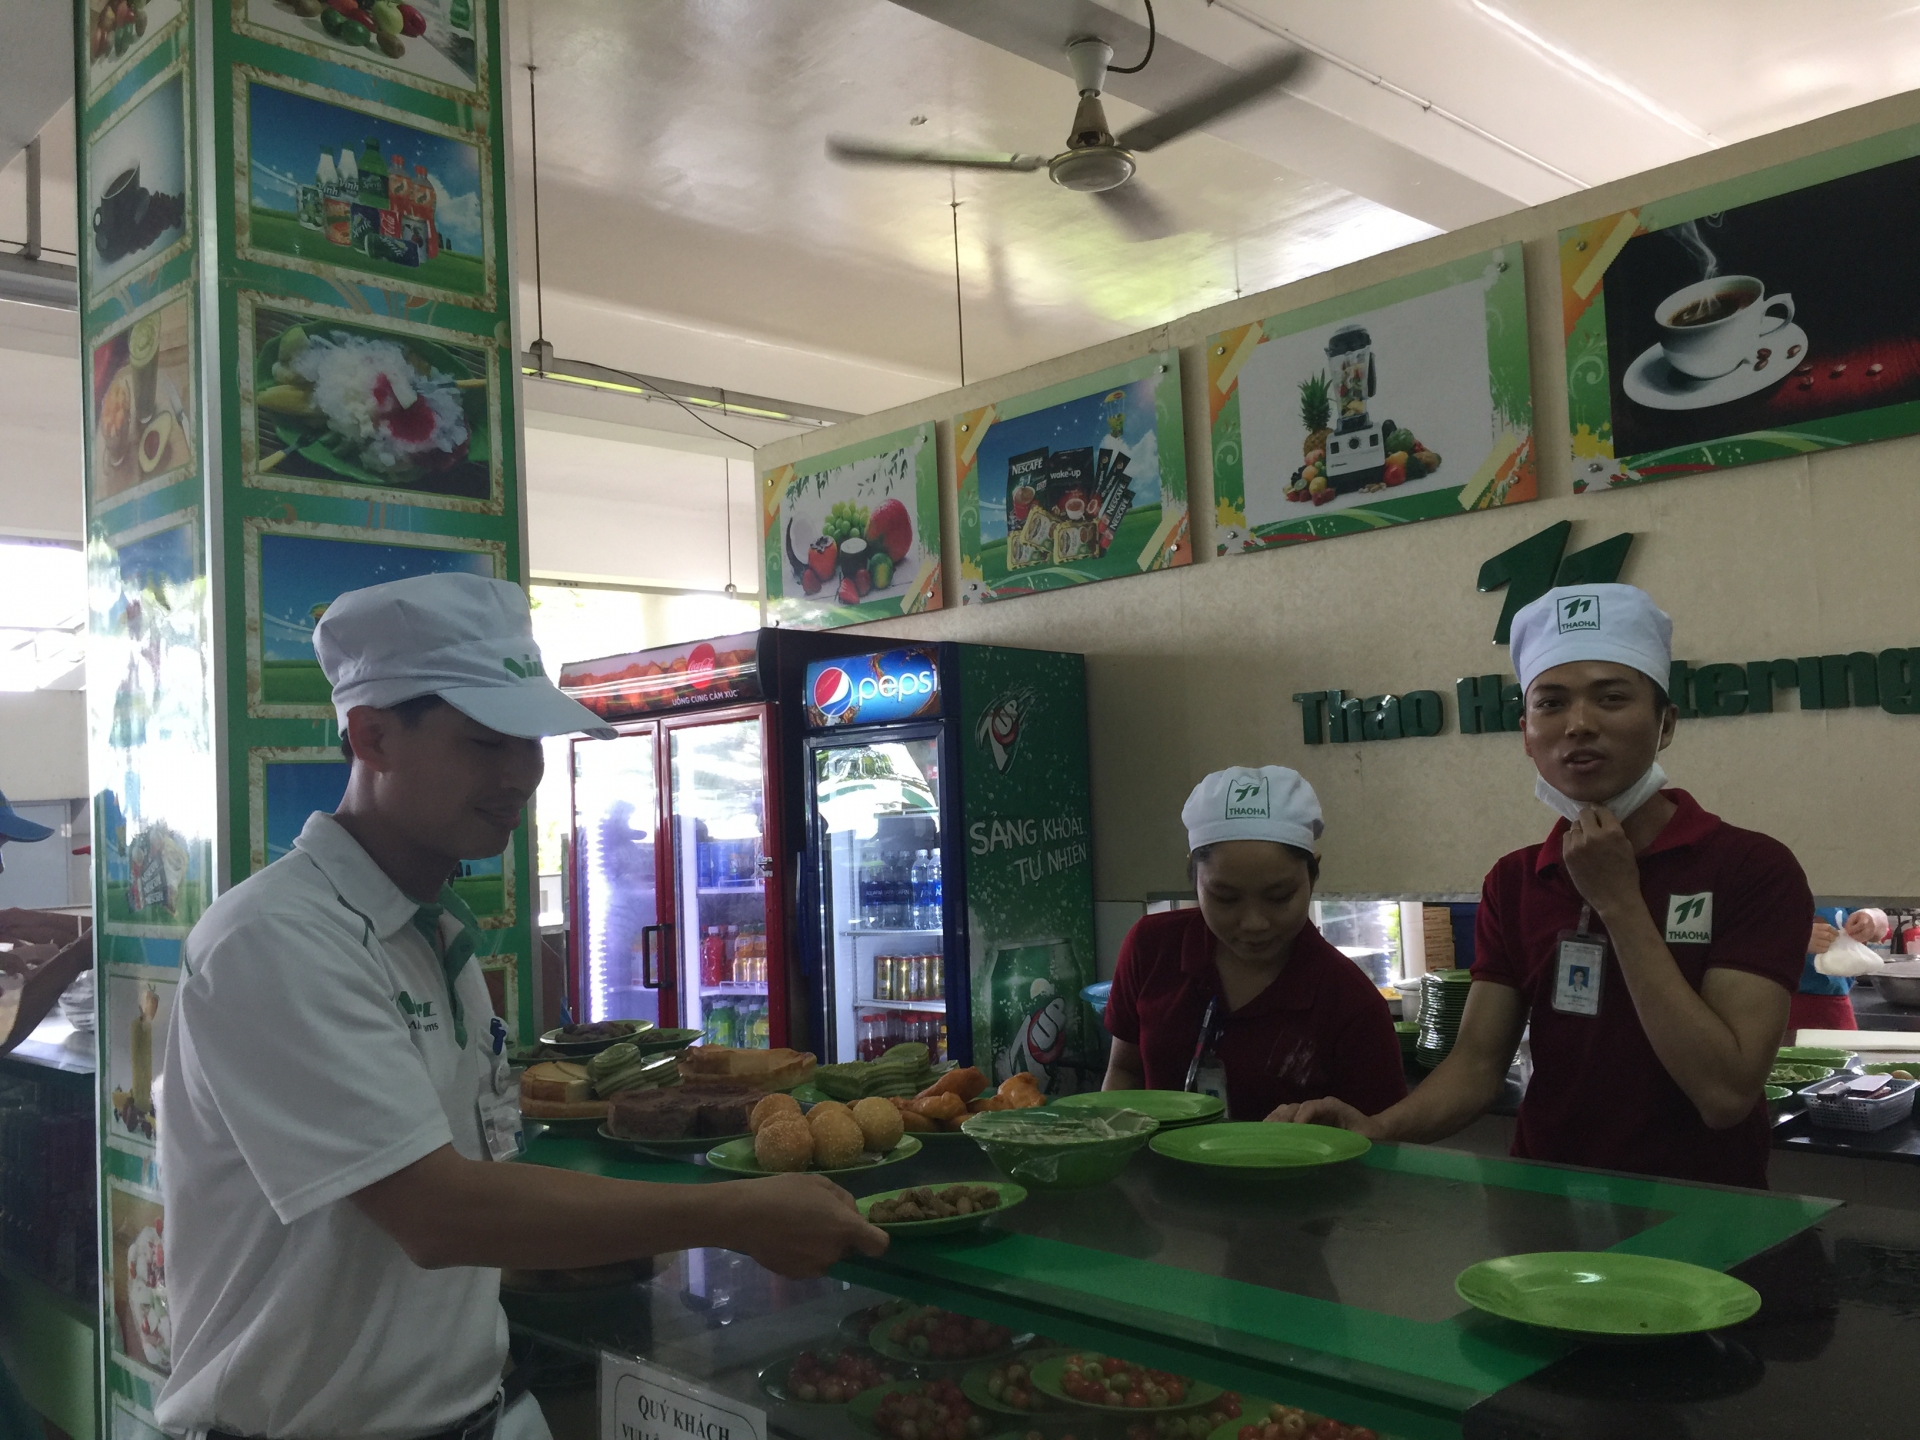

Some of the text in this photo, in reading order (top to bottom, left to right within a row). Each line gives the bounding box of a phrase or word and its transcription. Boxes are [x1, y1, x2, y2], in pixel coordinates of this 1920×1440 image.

[1050, 468, 1081, 480] wake-up
[1561, 620, 1597, 630] THAOHA
[858, 664, 938, 706] pepsi
[1294, 688, 1444, 746] Thao
[1229, 807, 1267, 816] THAOHA
[1047, 840, 1087, 875] NHIÊN
[1668, 930, 1710, 940] THAOHA
[638, 1394, 730, 1440] QUÝ KHÁCH
